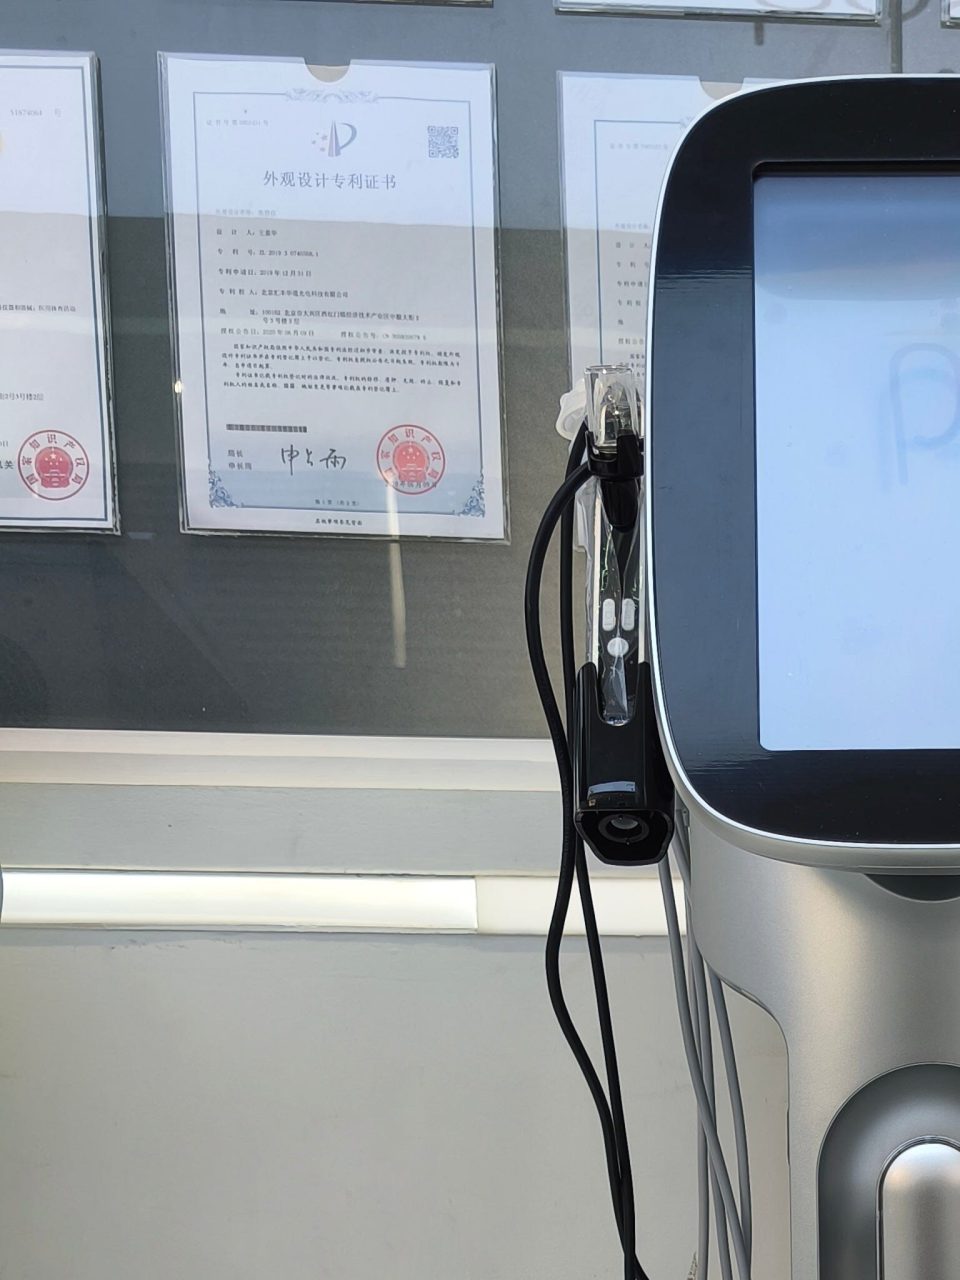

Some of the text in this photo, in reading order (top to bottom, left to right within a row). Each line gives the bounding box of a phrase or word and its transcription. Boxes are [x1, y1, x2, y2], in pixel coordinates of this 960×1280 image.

[264, 169, 397, 190] 外观设计专利证书
